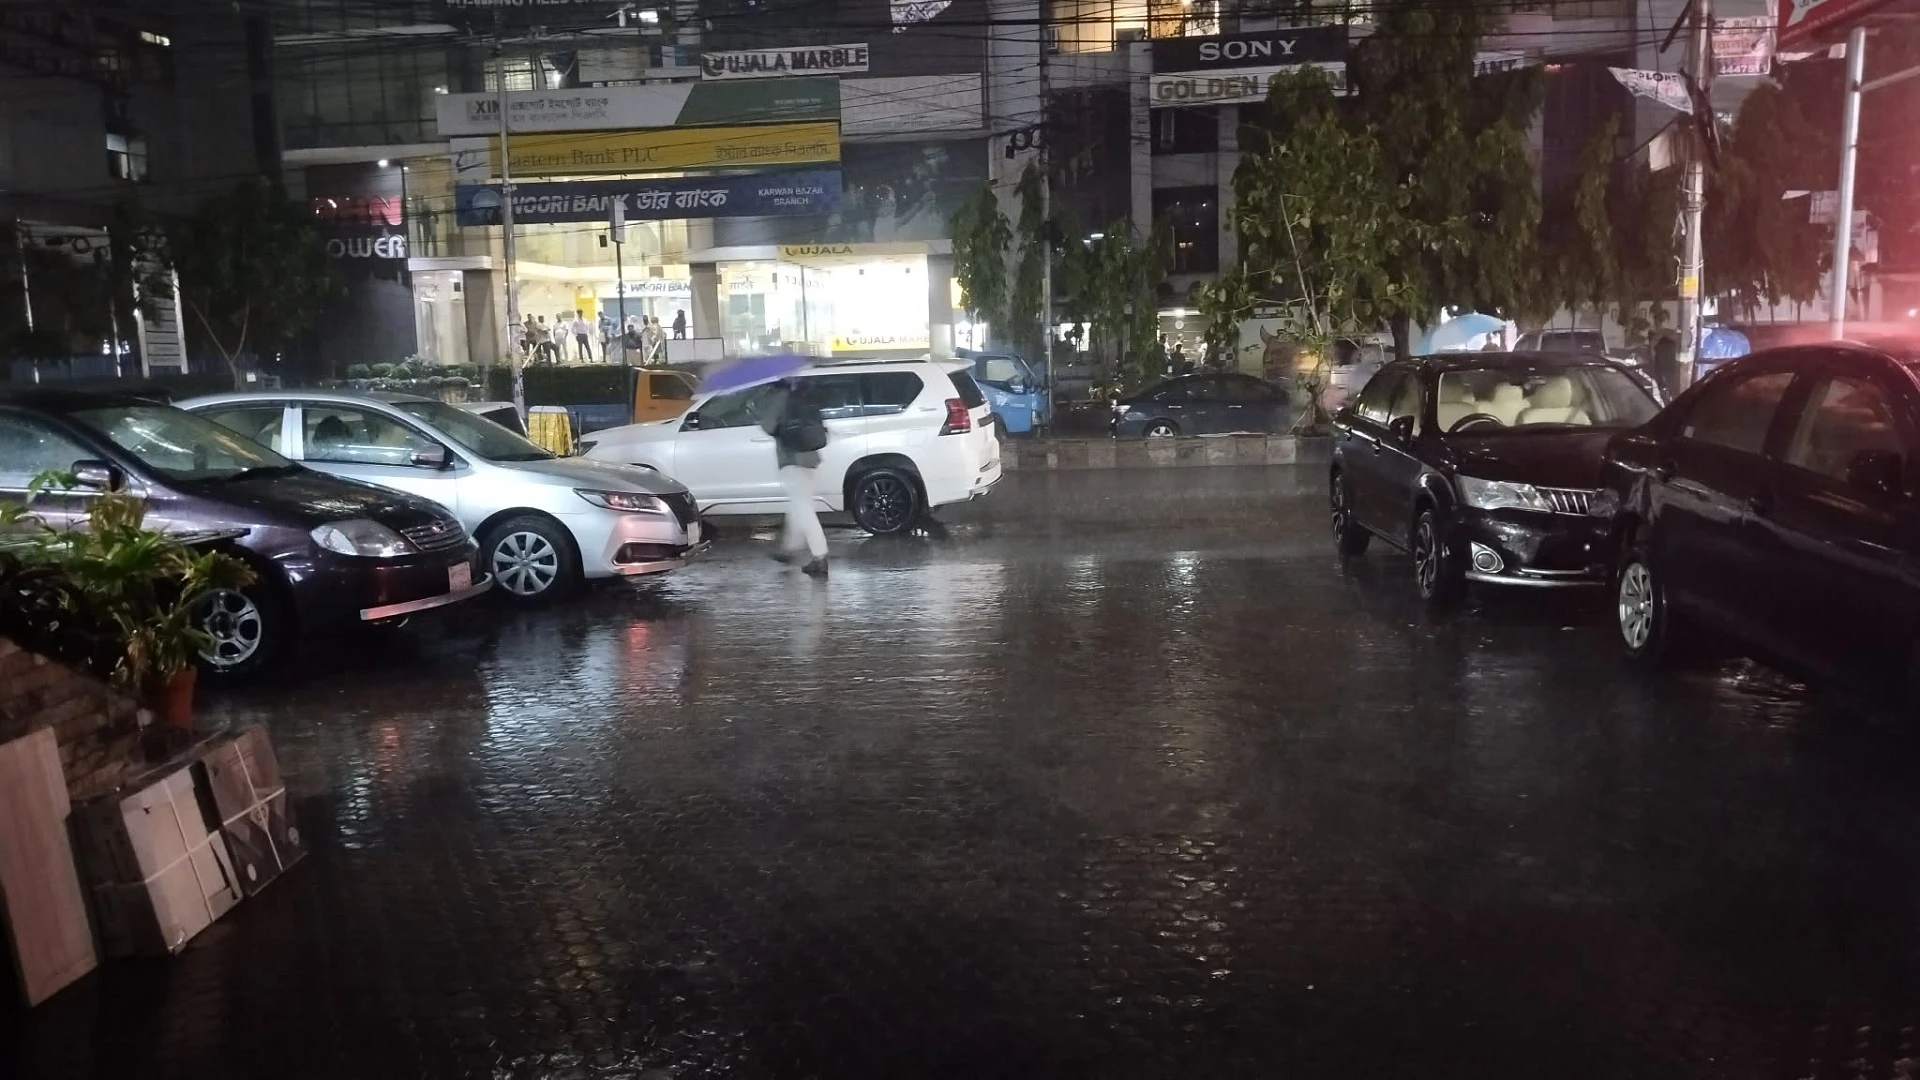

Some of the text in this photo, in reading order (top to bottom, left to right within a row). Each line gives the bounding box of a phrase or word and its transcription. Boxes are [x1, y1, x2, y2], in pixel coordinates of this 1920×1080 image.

[727, 48, 867, 73] UJALA MARBLE
[1199, 40, 1297, 61] SONY
[1156, 76, 1259, 99] GOLDEN
[509, 146, 659, 166] astern Bank PLC
[674, 189, 729, 208] ব্যাংক
[758, 186, 824, 196] KARWAN BAZAR
[571, 193, 630, 213] BANK
[773, 197, 809, 206] BRANCH
[327, 235, 406, 259] OWER
[800, 245, 853, 255] UJALA
[859, 336, 896, 345] UJALA
